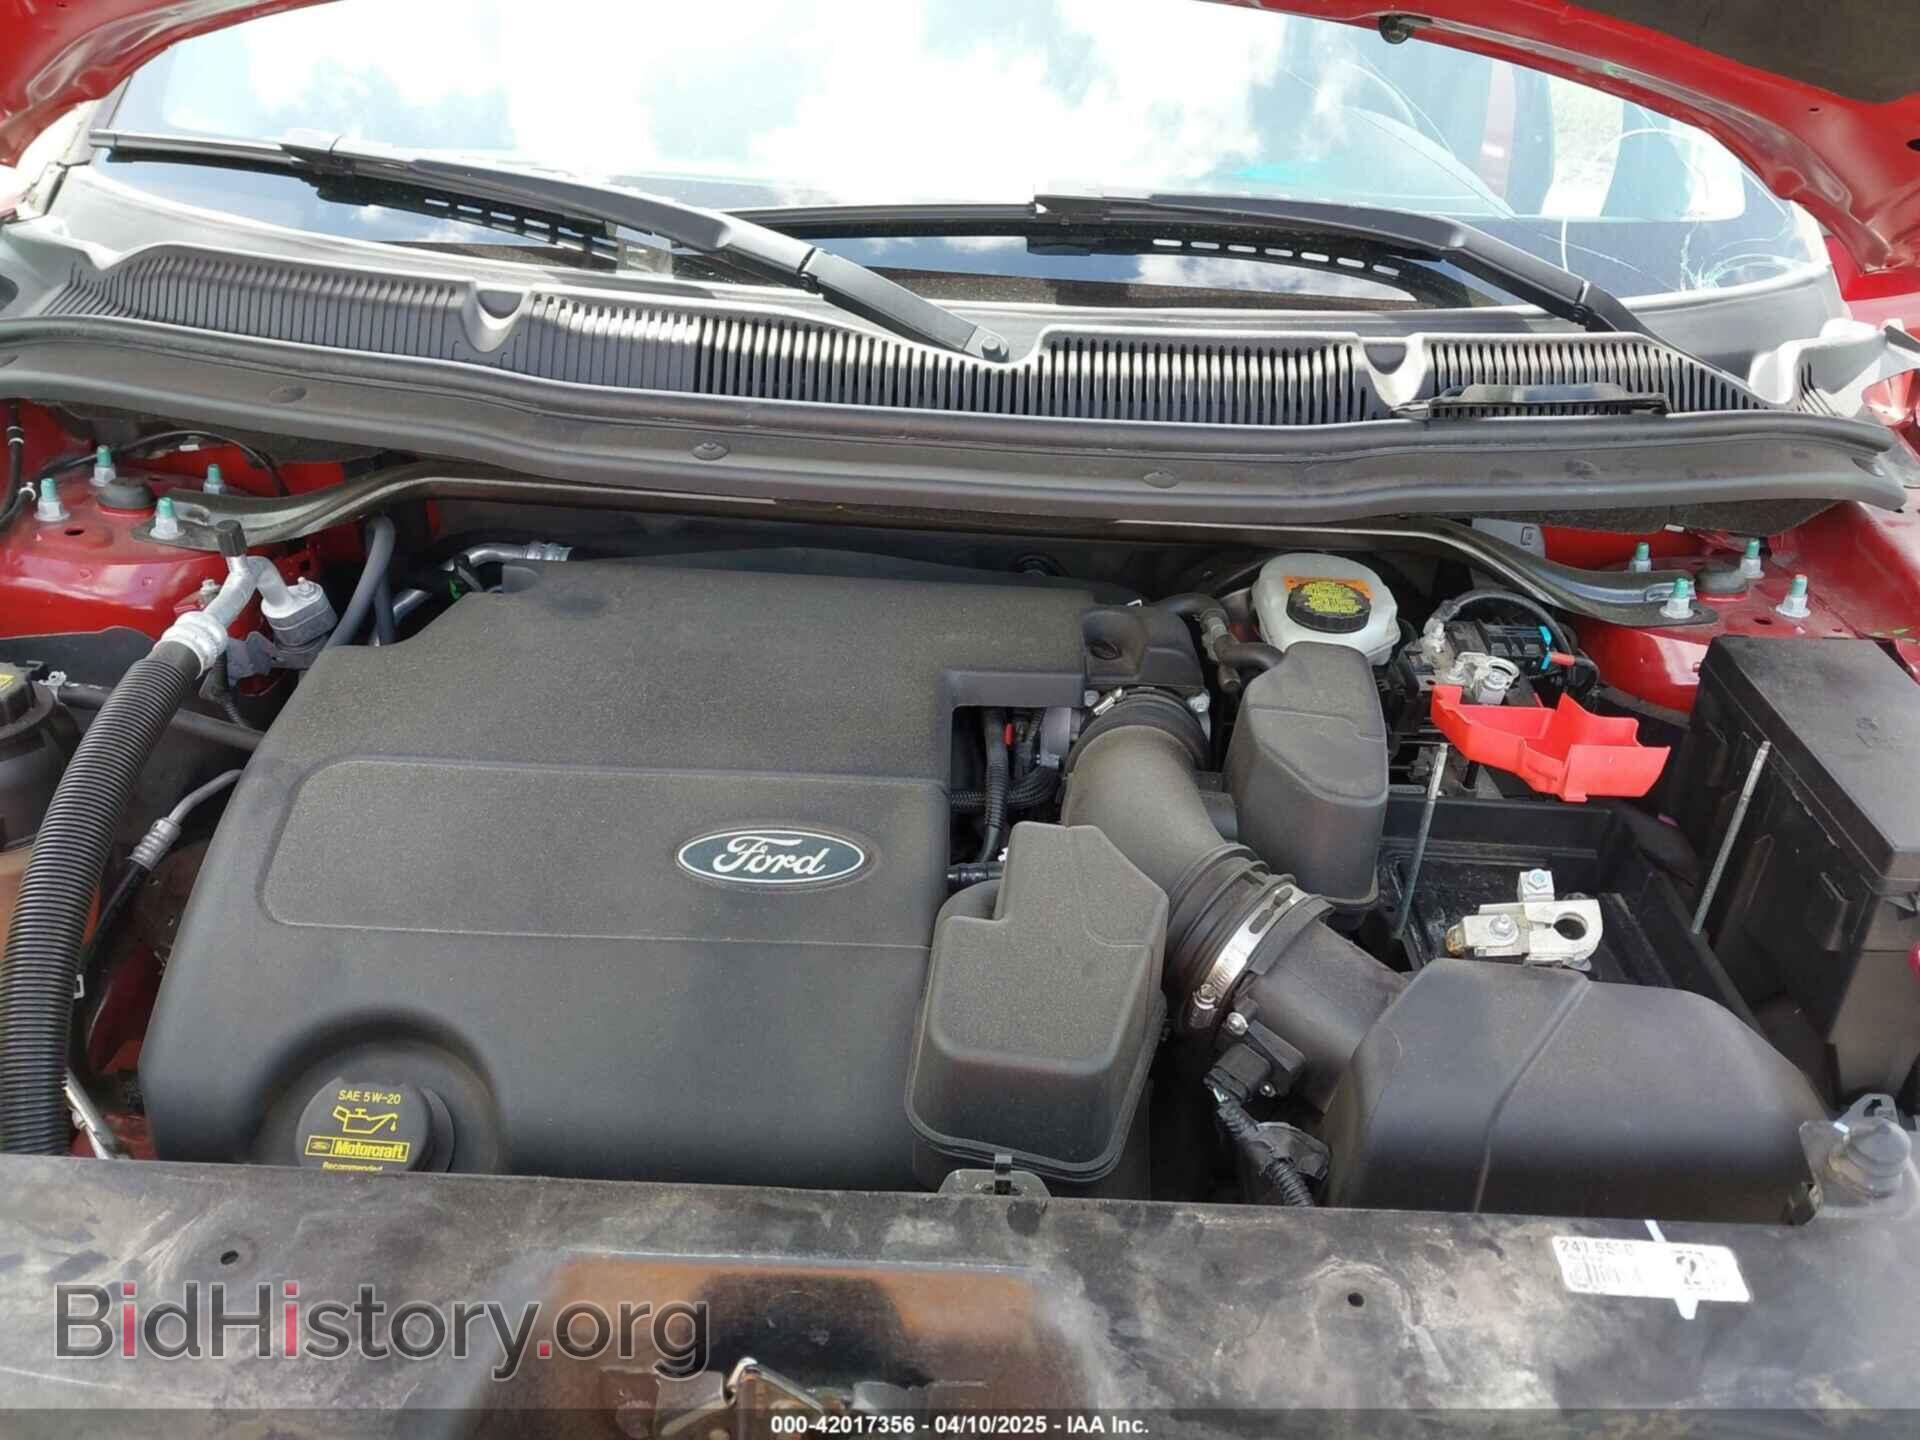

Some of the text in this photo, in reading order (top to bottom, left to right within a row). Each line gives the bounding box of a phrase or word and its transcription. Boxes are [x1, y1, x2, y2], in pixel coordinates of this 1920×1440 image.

[712, 835, 830, 875] Ford
[338, 1090, 360, 1102] SAE
[335, 1141, 404, 1159] Motorcraft
